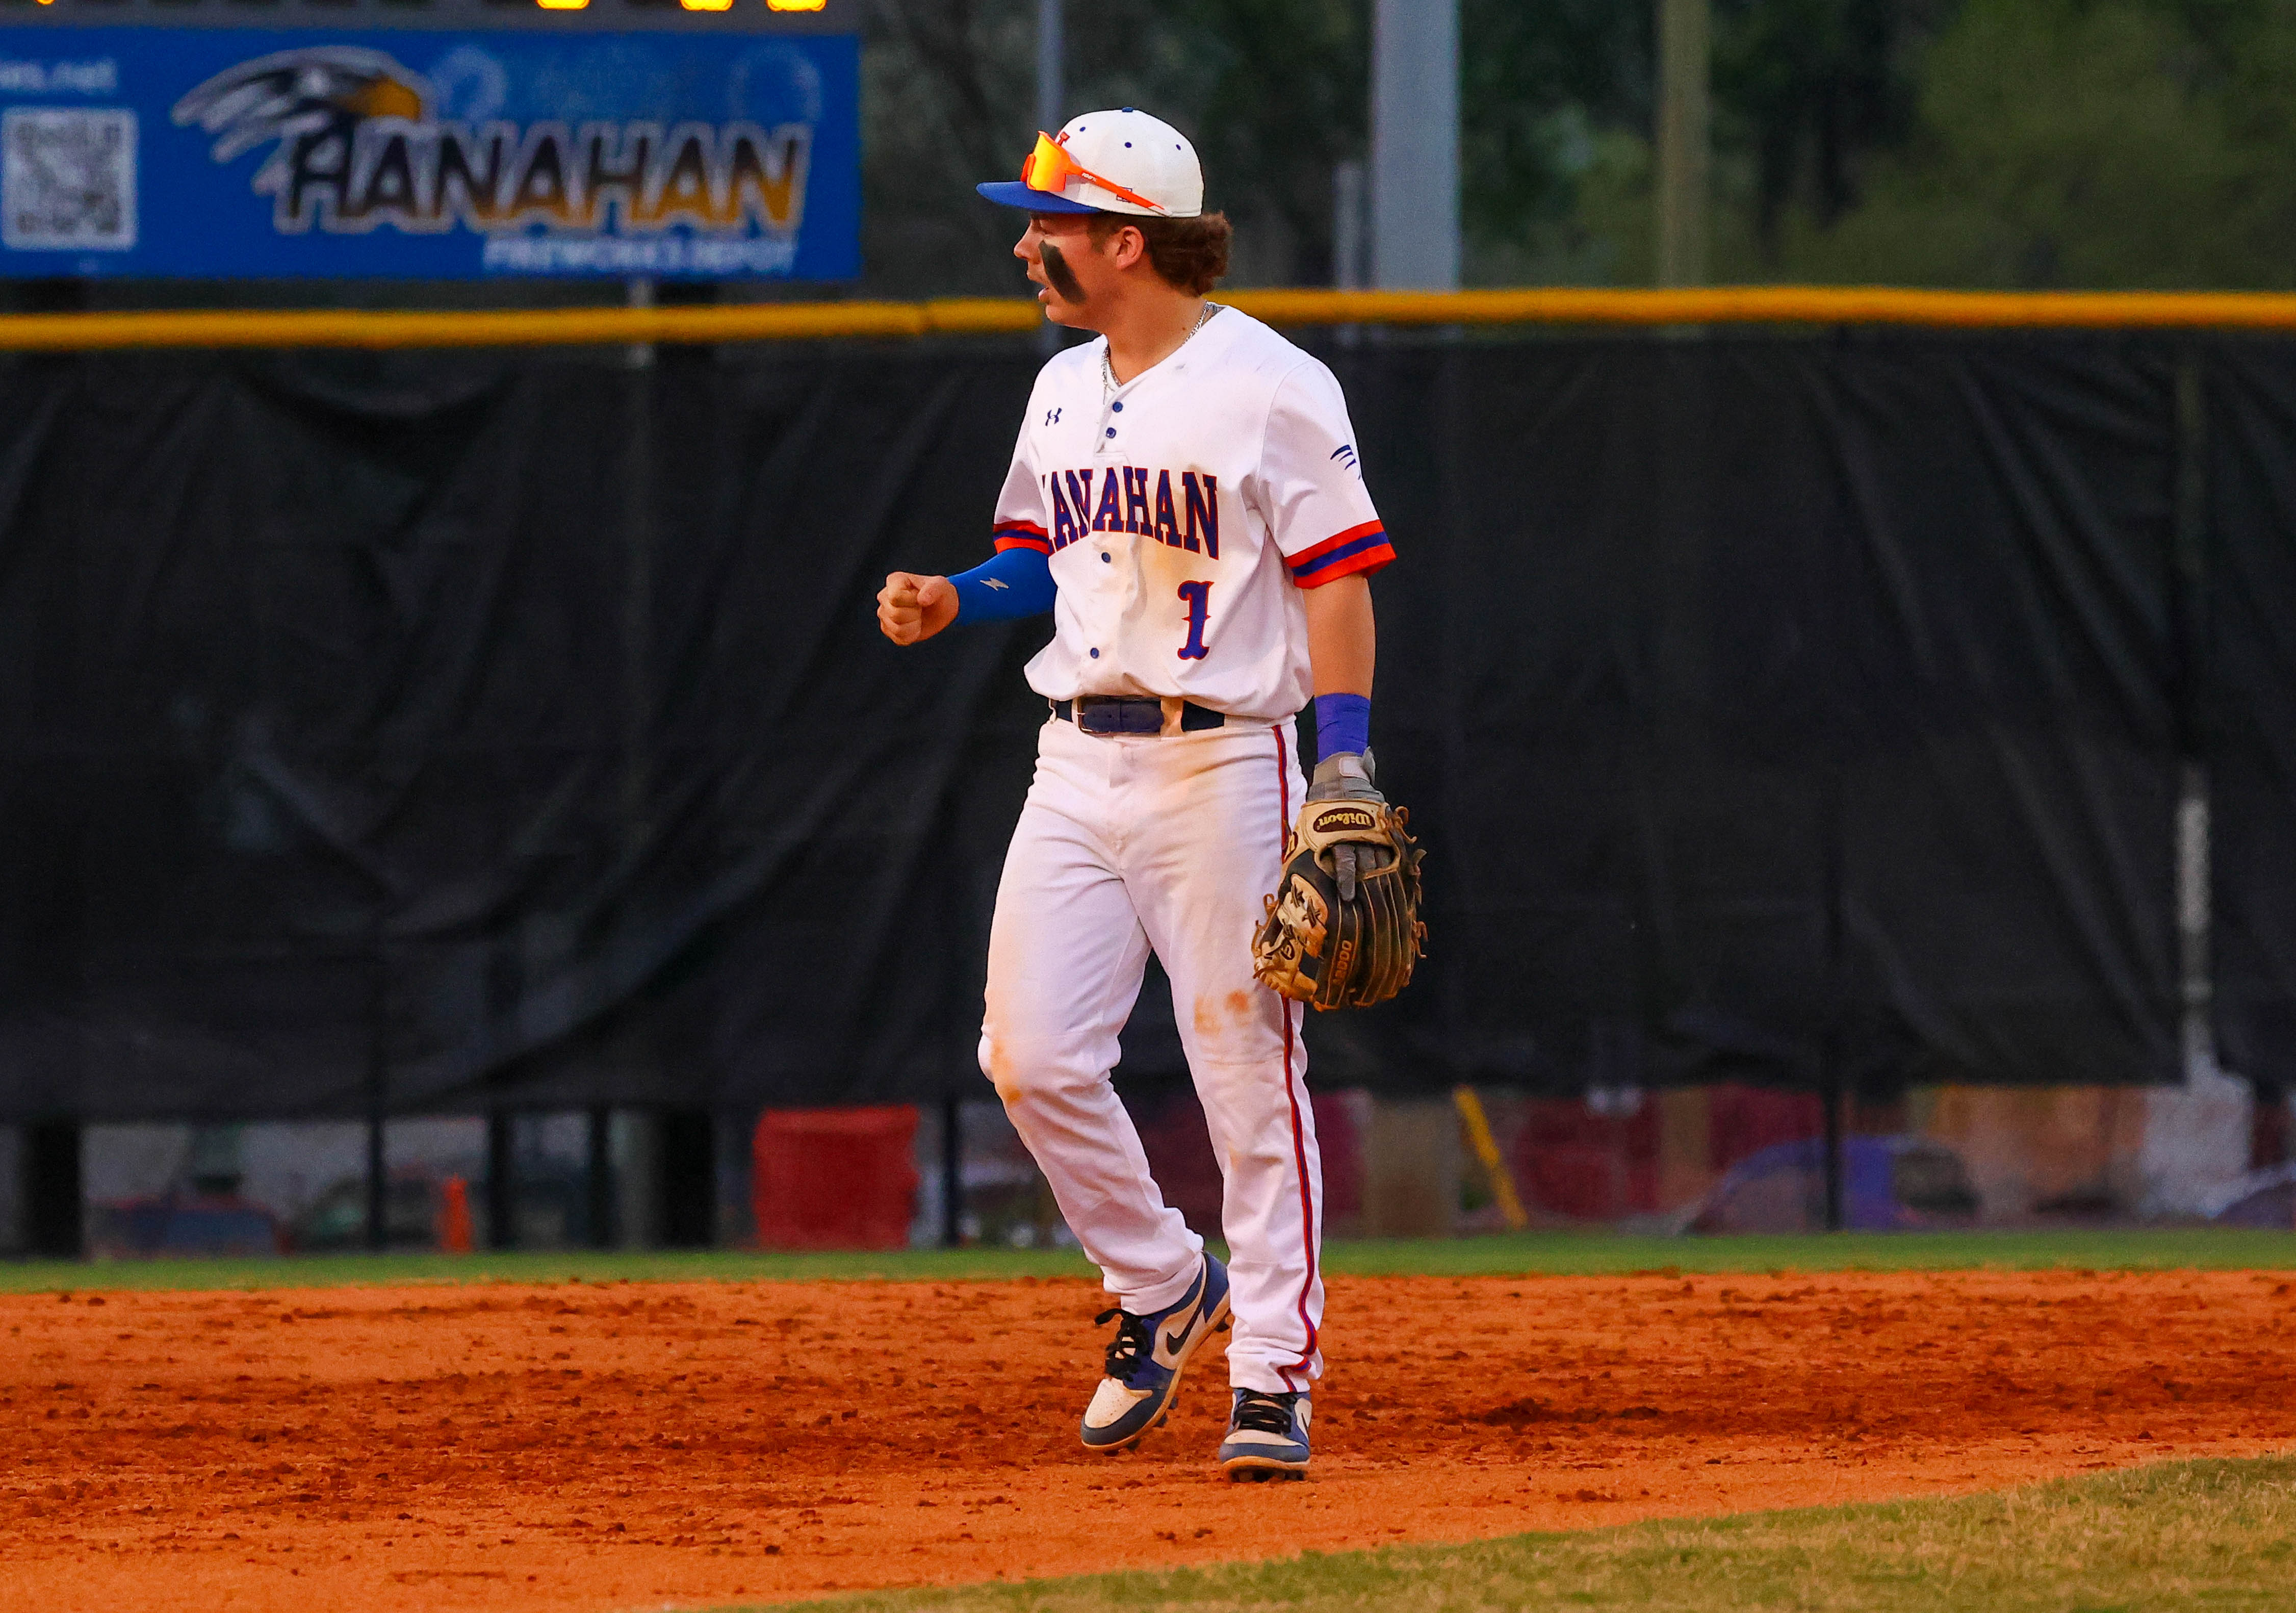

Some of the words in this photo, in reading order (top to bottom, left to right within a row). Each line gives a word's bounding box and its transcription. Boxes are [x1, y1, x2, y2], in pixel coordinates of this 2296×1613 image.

[275, 120, 811, 233] HANAHAN
[1042, 466, 1219, 560] ANAHAN
[1177, 580, 1215, 660] 1
[1318, 812, 1372, 826] Wilson
